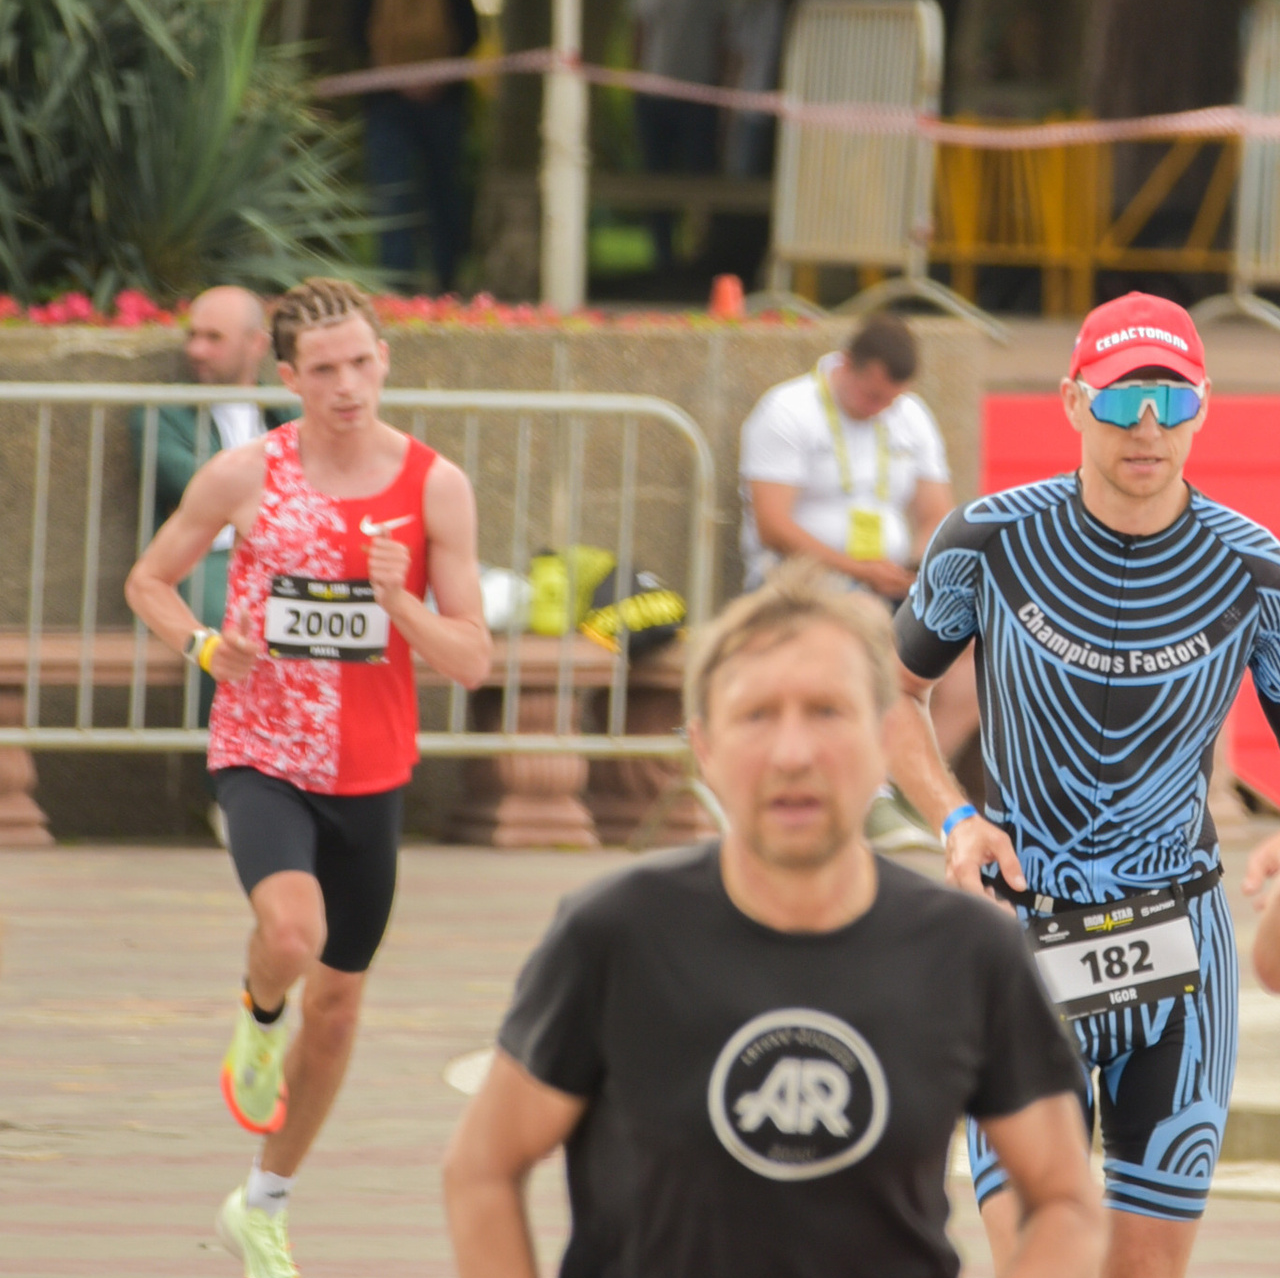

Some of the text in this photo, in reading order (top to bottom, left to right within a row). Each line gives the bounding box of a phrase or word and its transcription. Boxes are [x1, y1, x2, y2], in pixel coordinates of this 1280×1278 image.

[1096, 327, 1188, 352] СЕВАСТОПОЛЬ
[286, 609, 367, 638] 2000
[1018, 601, 1211, 674] Champions Factory
[1083, 913, 1105, 928] IRON
[1111, 906, 1134, 922] STAR
[1080, 939, 1154, 985] 182
[1109, 987, 1138, 1005] IGOR
